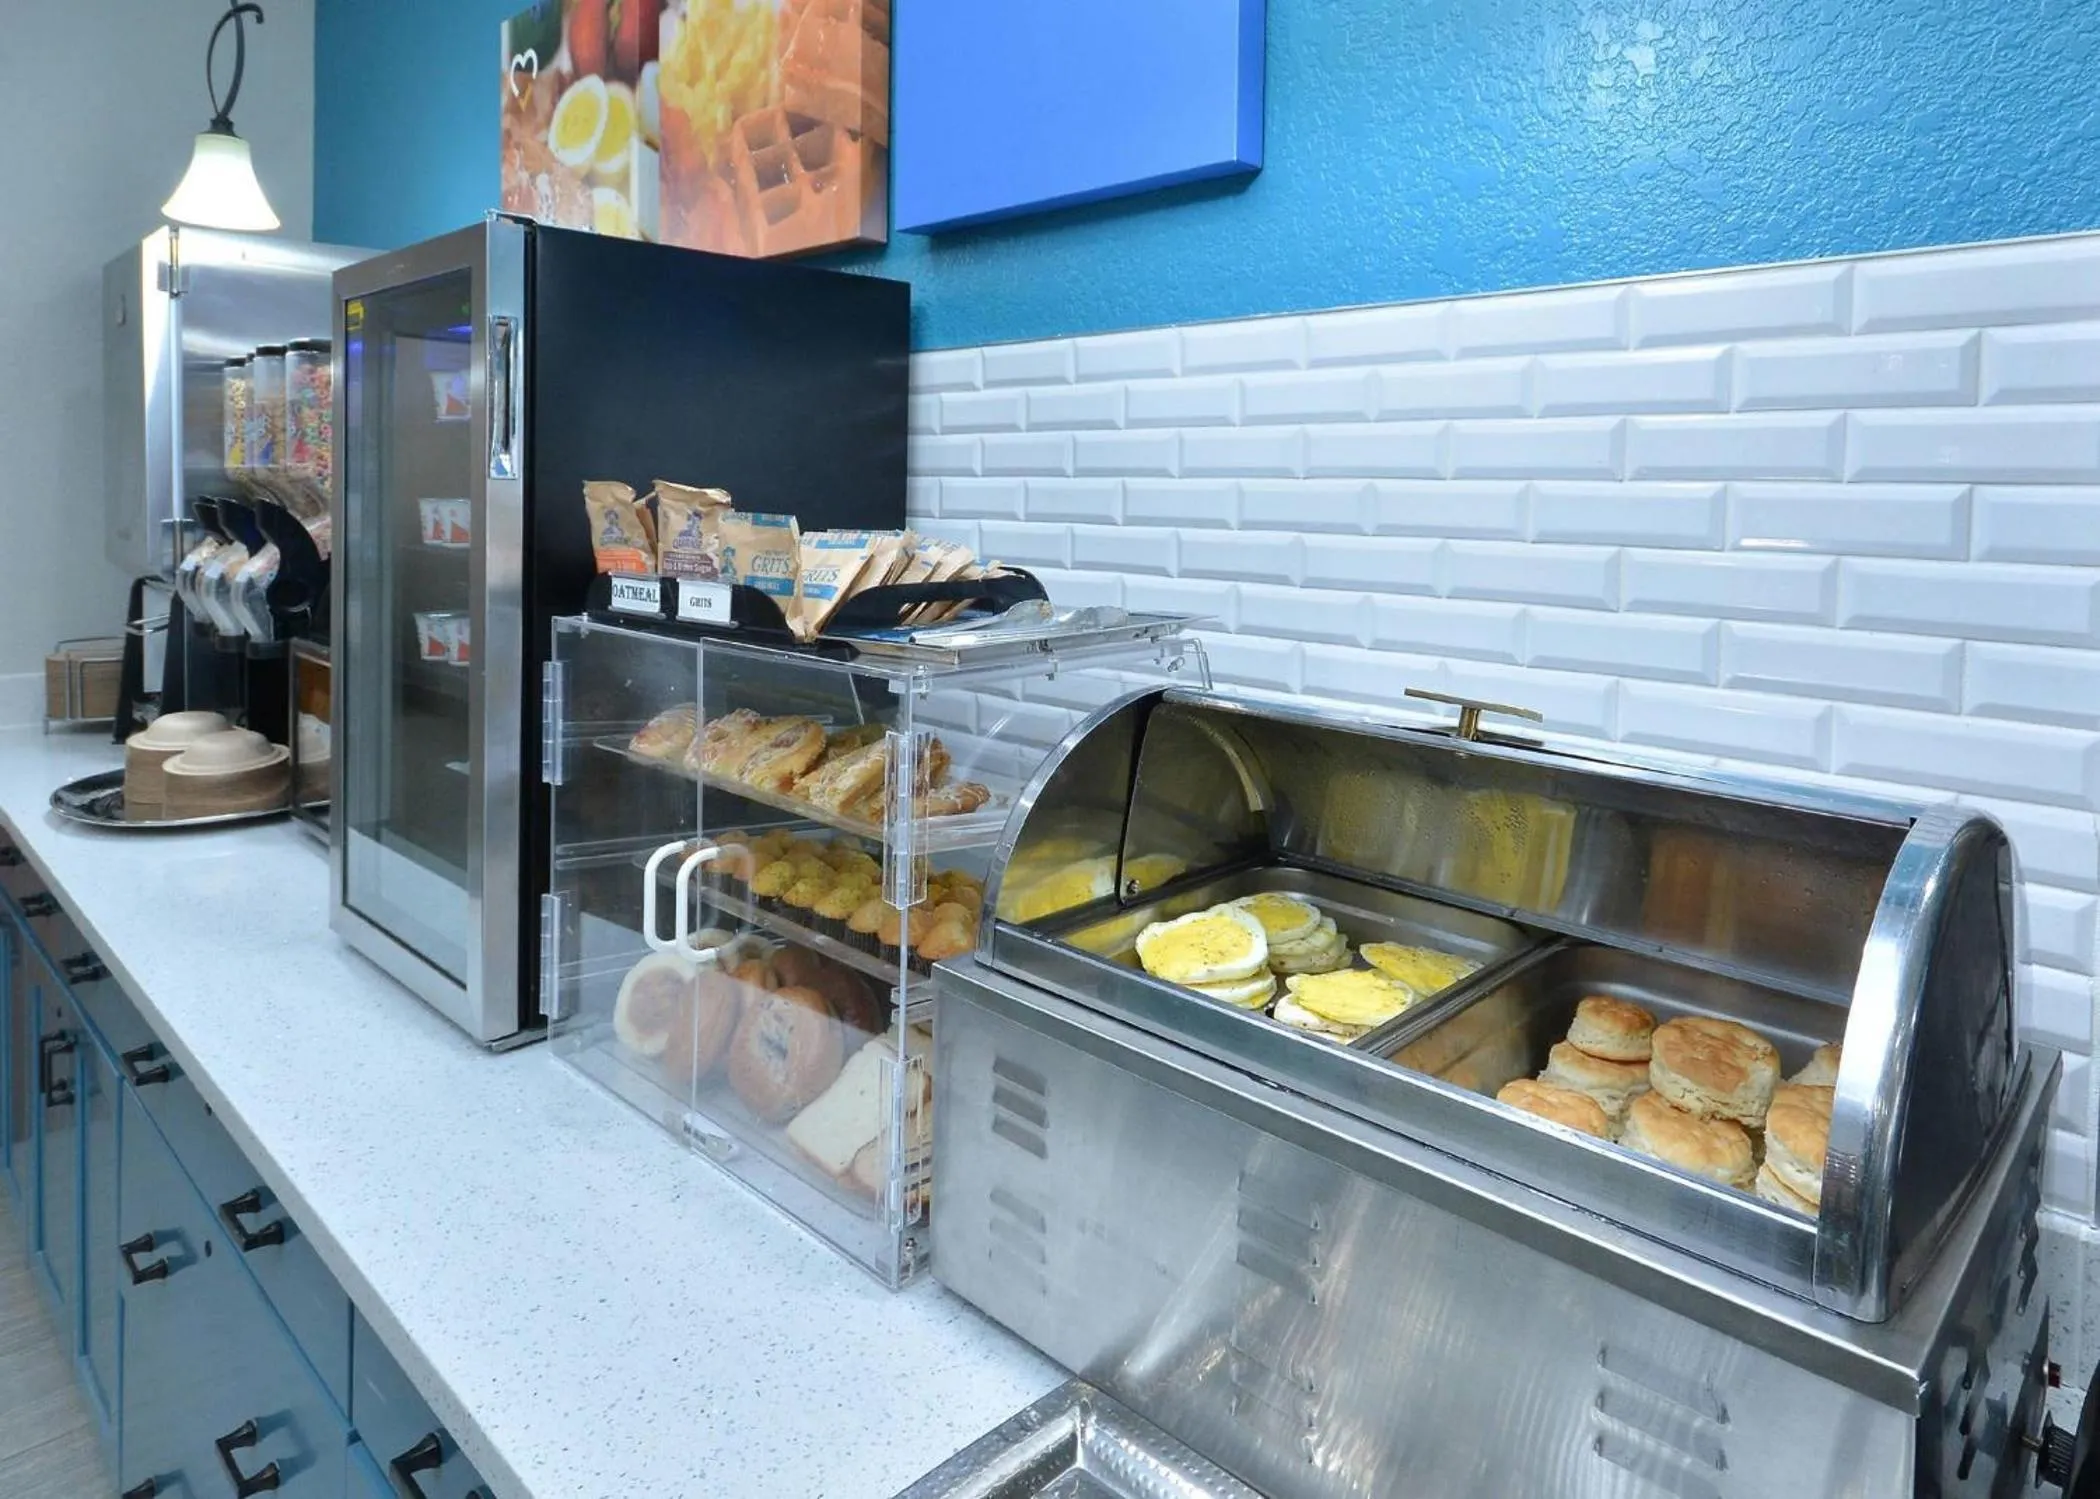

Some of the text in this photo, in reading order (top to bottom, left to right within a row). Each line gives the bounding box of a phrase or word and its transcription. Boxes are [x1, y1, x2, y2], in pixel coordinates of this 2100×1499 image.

[751, 554, 791, 575] GRITS
[803, 568, 840, 583] RITS
[613, 583, 659, 603] OATMEAL
[689, 596, 712, 609] GRITS
